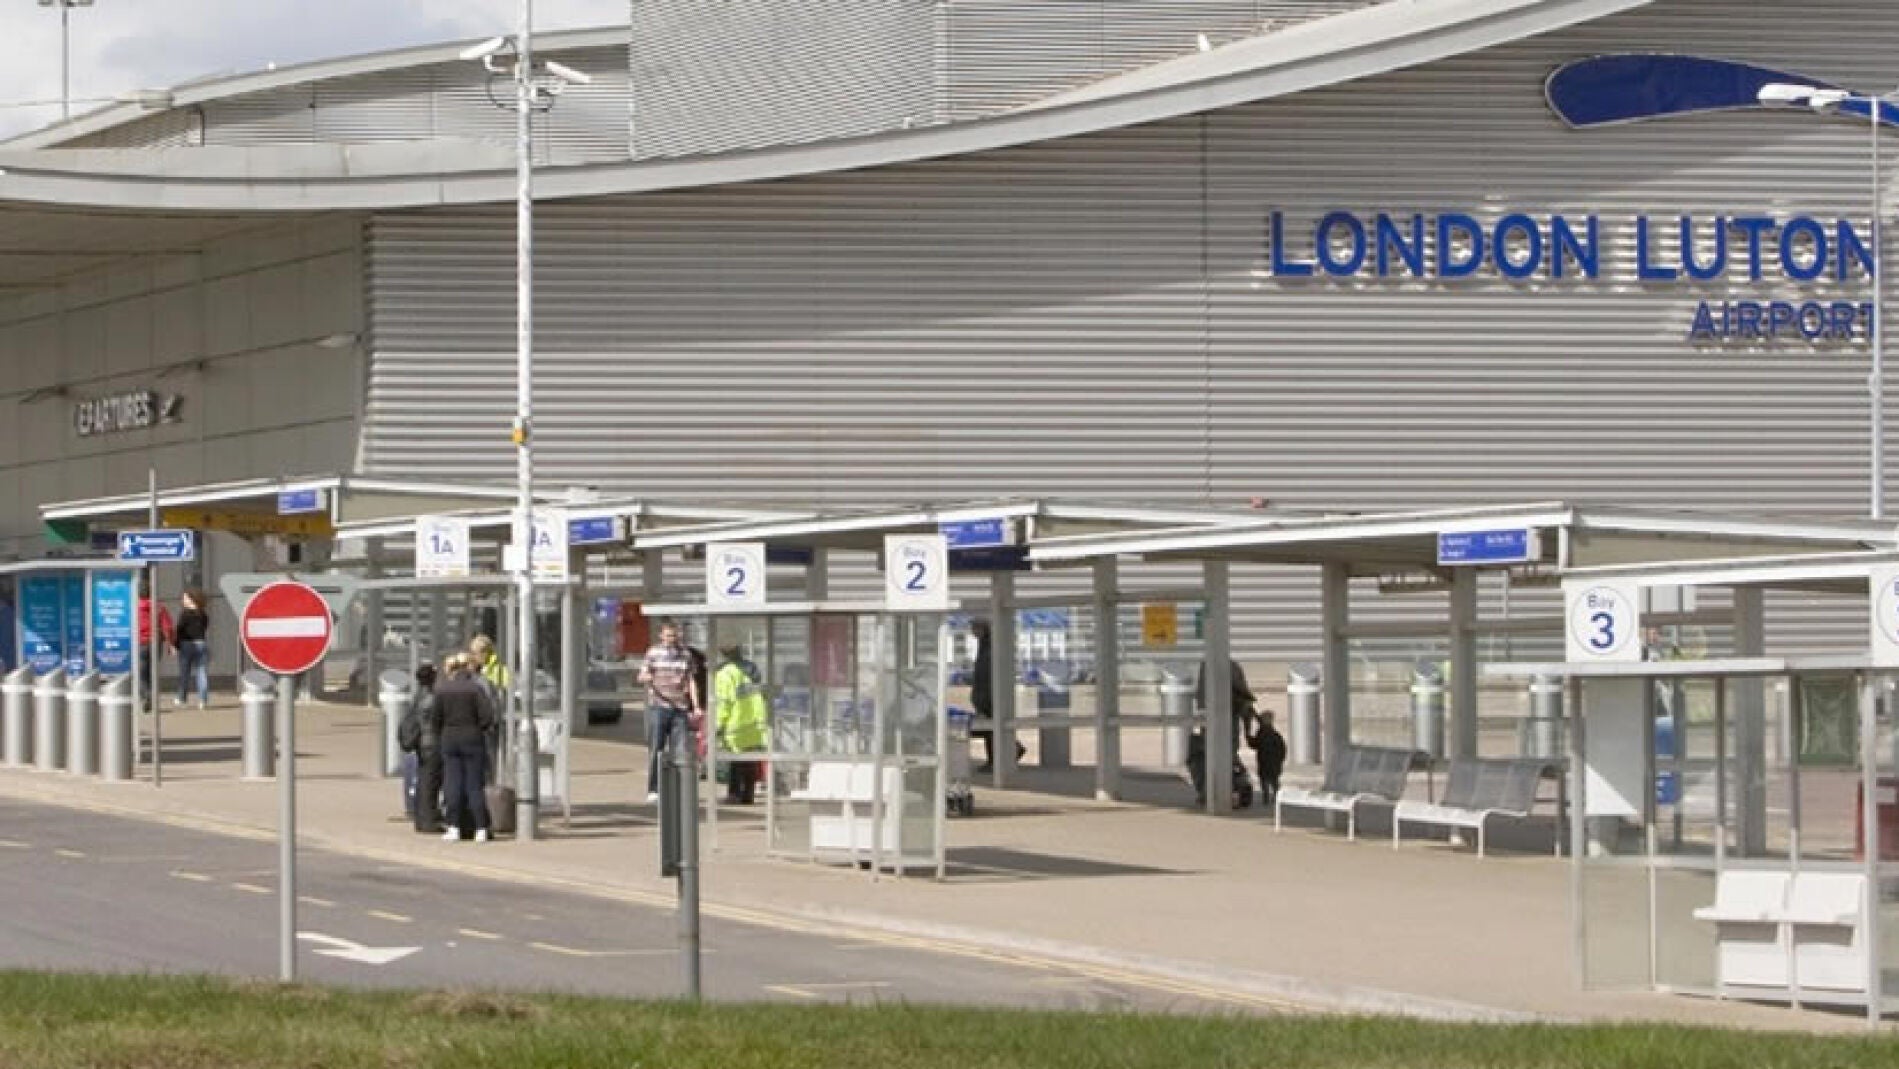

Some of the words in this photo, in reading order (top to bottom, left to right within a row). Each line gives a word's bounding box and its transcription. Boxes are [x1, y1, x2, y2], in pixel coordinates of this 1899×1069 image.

[1270, 210, 1598, 279] LONDON
[1636, 215, 1875, 282] LUTON
[726, 567, 746, 595] 2
[906, 560, 926, 590] 2
[1586, 594, 1615, 610] Bay
[1590, 612, 1615, 649] 3
